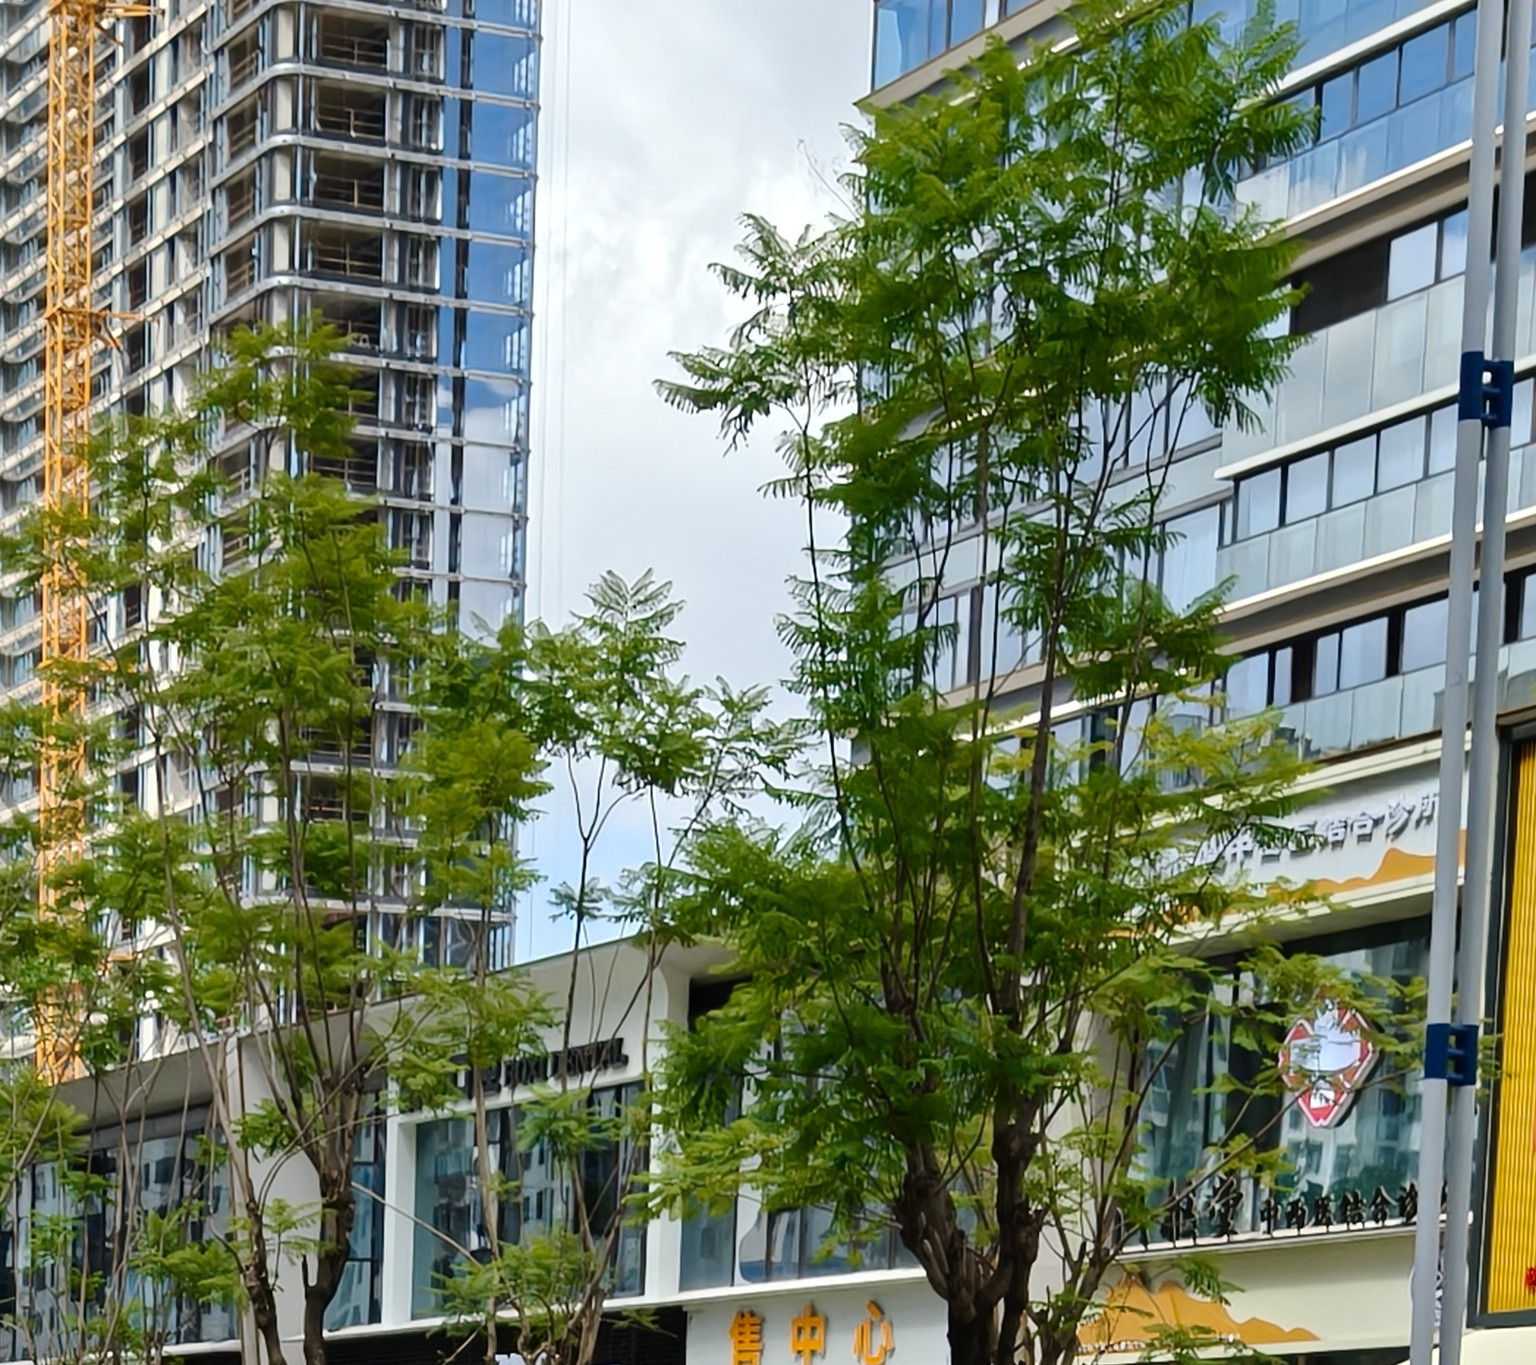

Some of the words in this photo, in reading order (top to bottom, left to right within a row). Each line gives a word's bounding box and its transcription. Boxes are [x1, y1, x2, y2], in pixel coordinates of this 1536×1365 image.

[1260, 1182, 1446, 1236] 中西医结合诊
